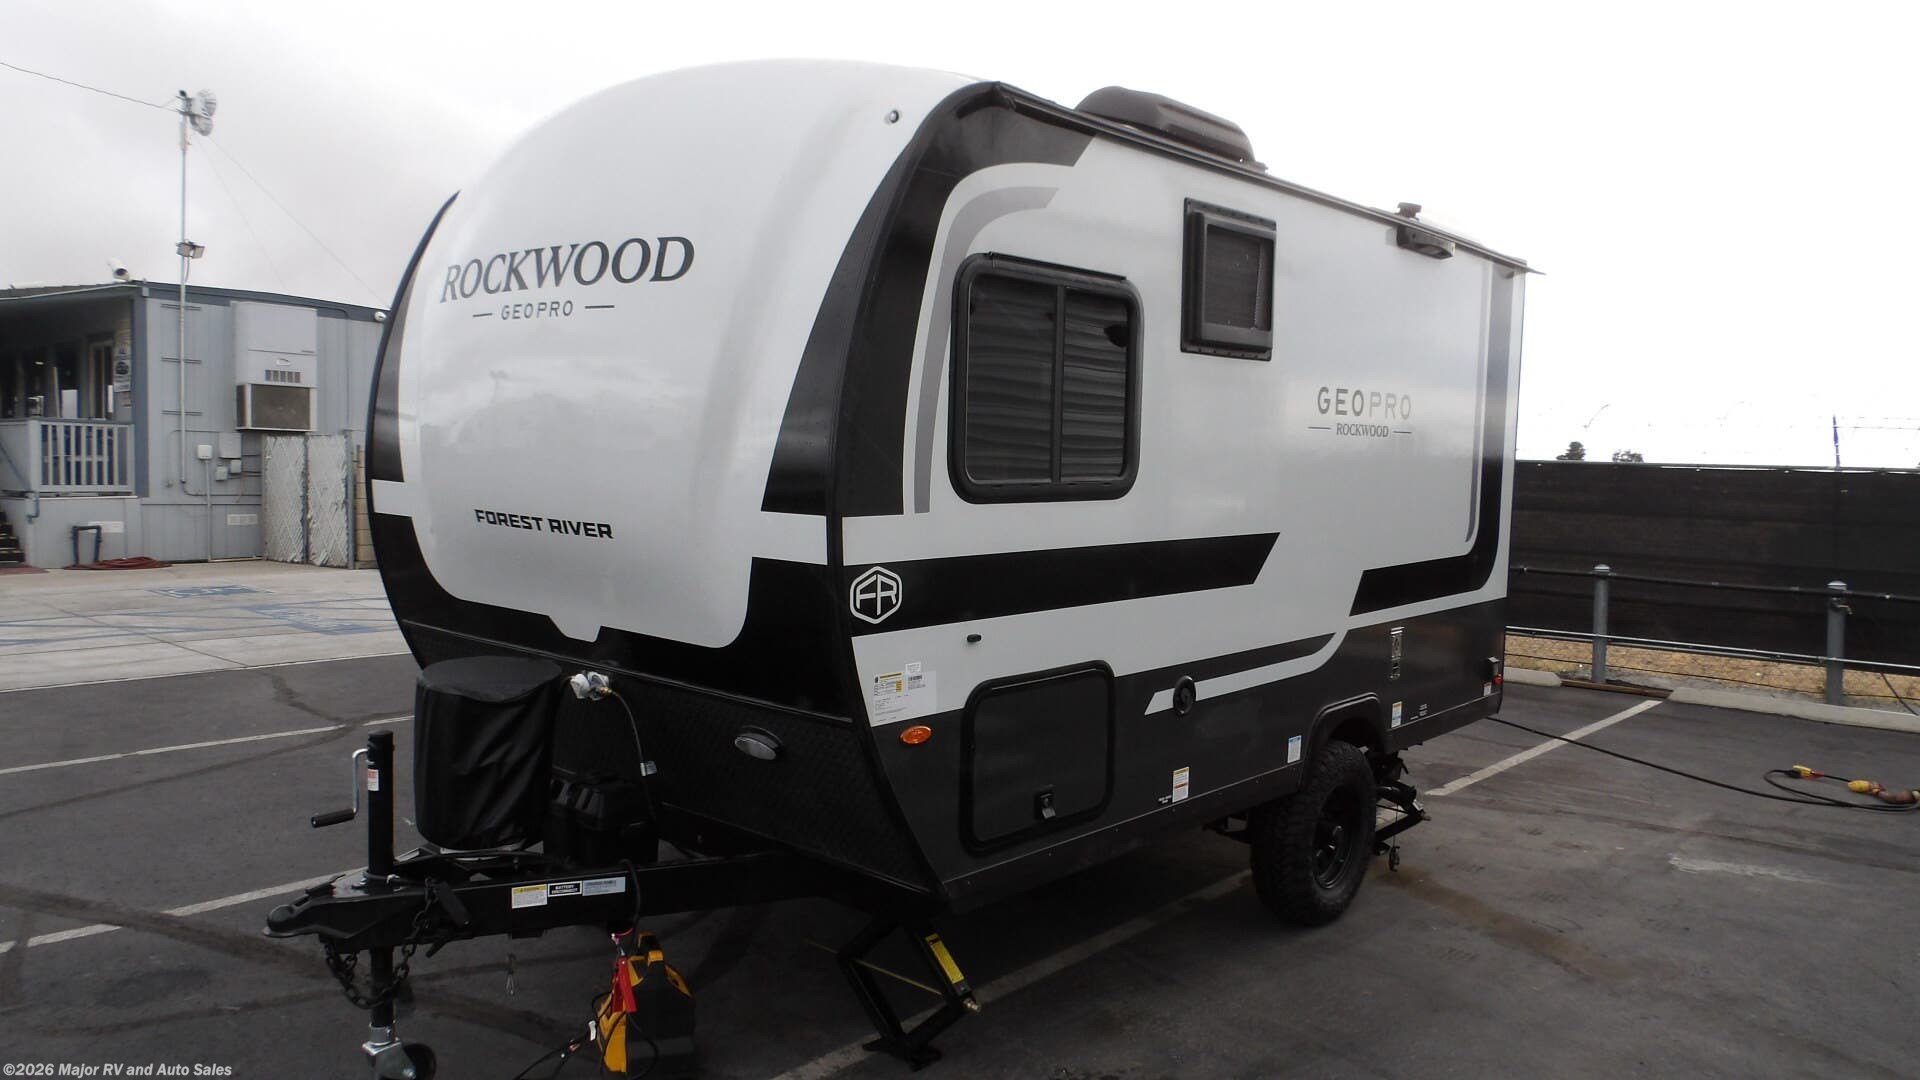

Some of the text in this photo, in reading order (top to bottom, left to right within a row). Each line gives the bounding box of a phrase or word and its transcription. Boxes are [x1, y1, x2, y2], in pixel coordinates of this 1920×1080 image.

[440, 236, 695, 303] ROCKWOOD
[501, 300, 573, 320] GEOPRO
[1317, 386, 1412, 420] GEOPRO
[1336, 423, 1389, 437] ROCKWOOD
[474, 509, 614, 539] FOREST RIVER
